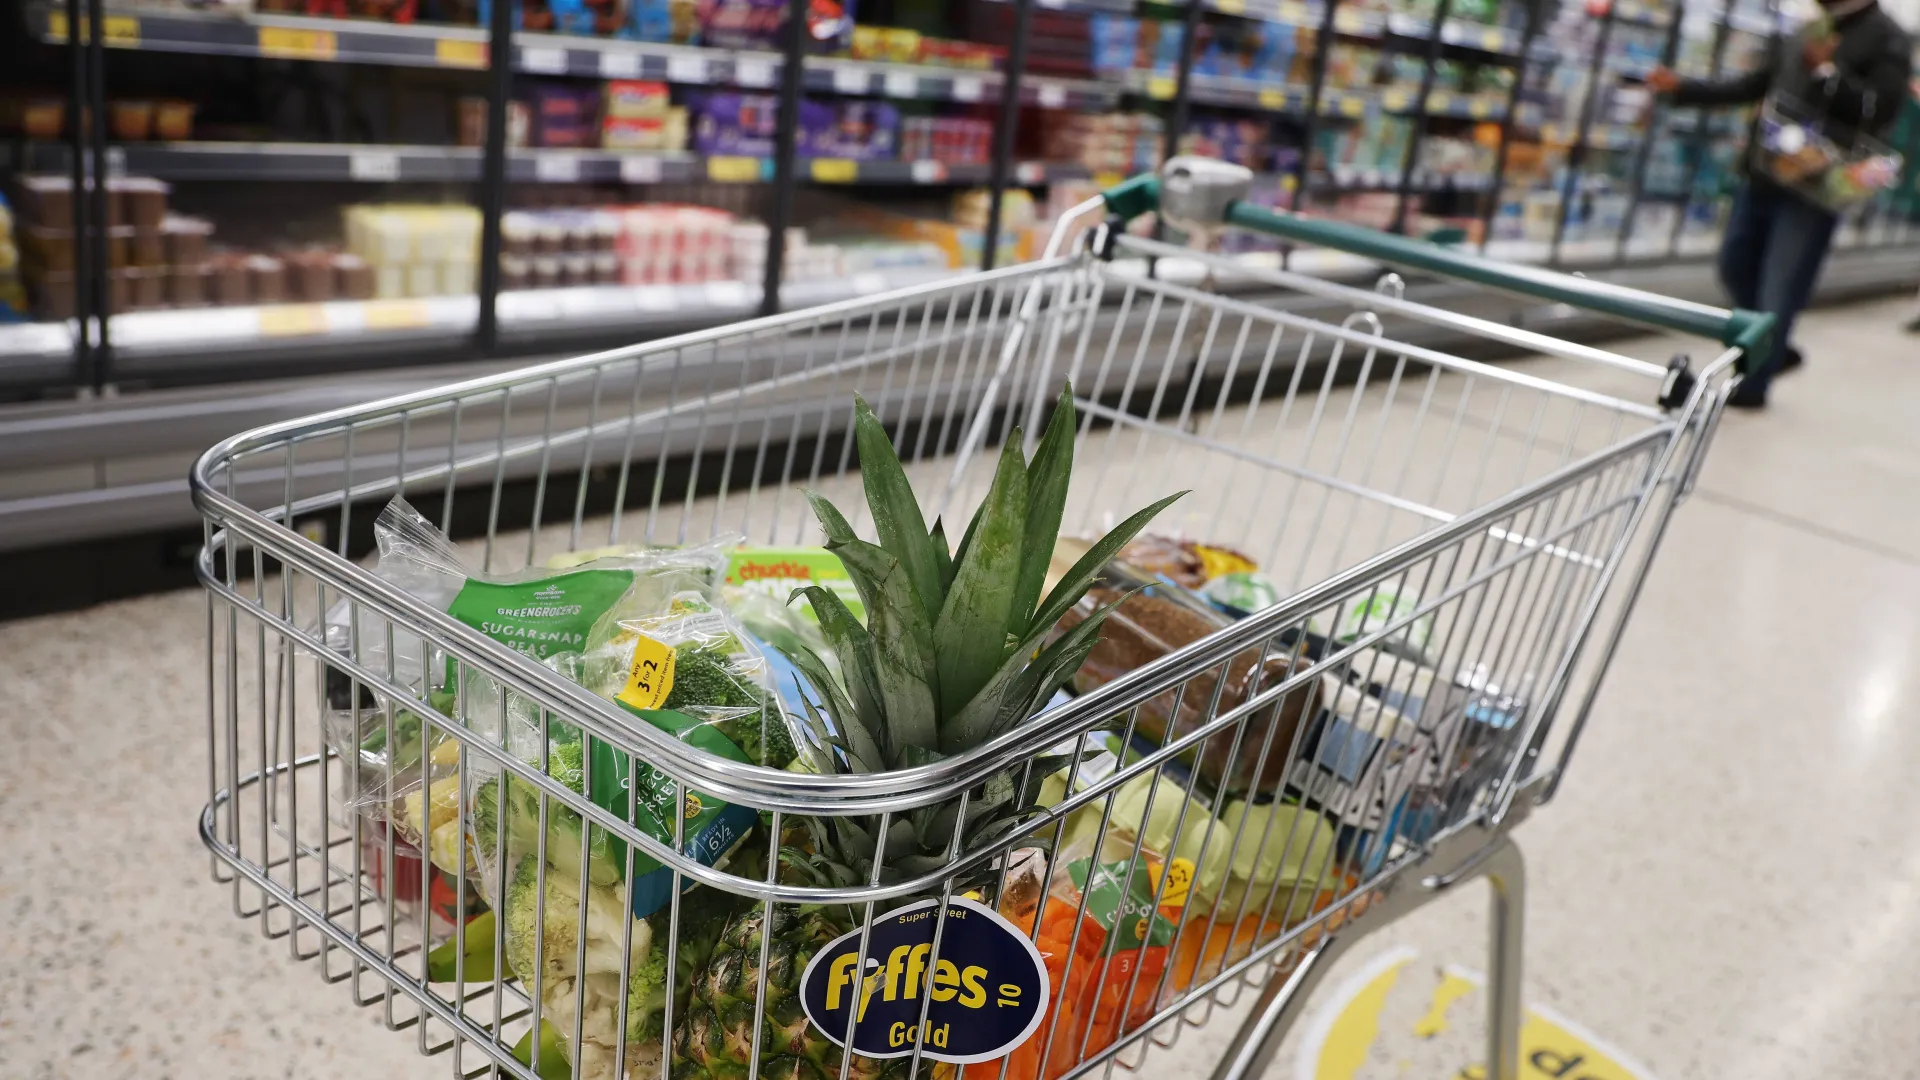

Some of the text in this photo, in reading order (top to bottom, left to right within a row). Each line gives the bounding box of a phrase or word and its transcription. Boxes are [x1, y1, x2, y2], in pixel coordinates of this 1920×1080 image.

[632, 662, 641, 678] Any
[637, 659, 658, 693] 3 for 2
[899, 911, 931, 924] Super
[997, 983, 1022, 1008] 10
